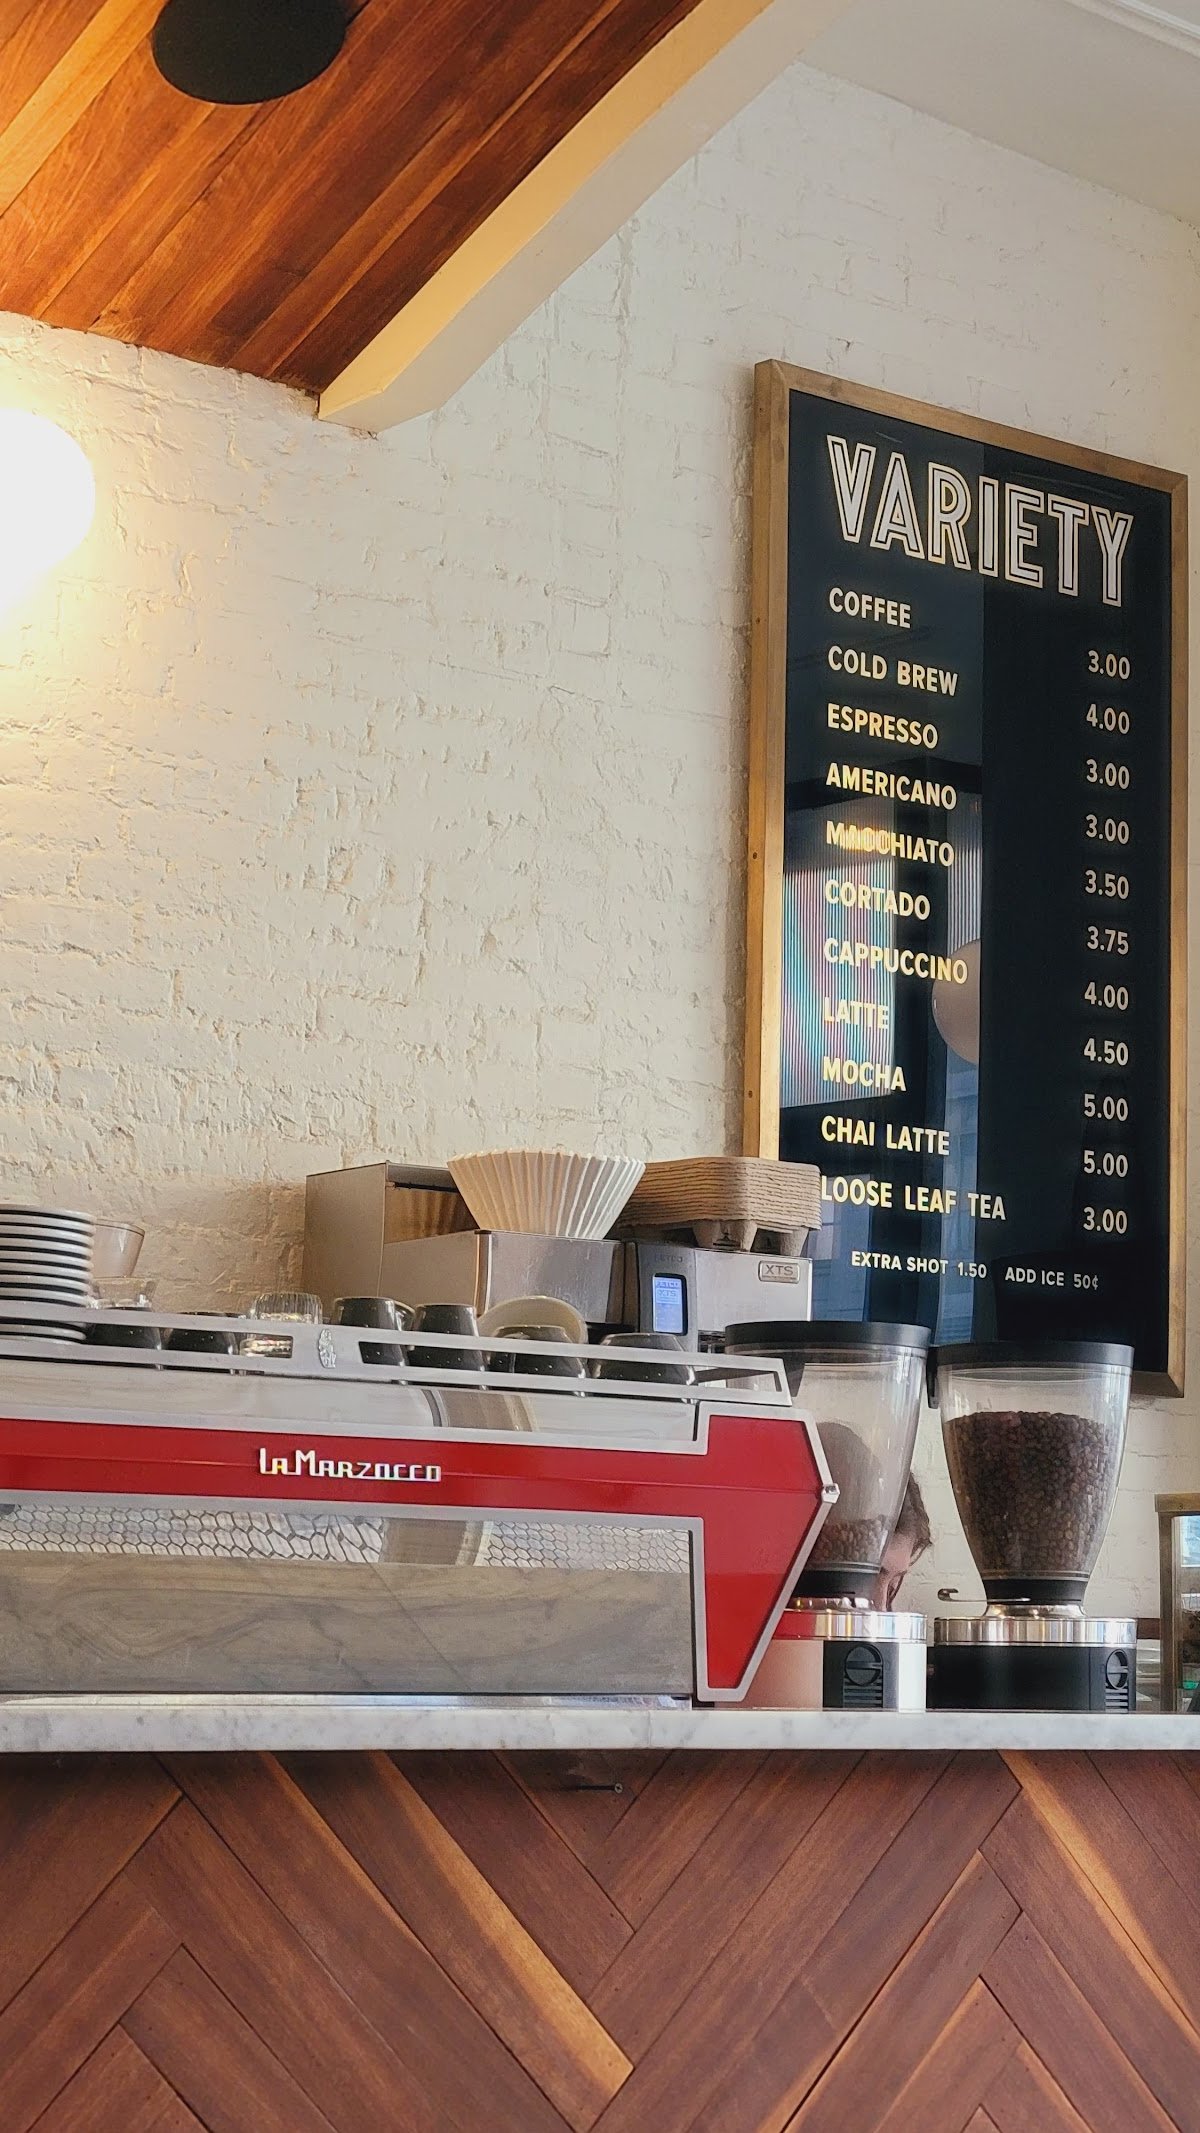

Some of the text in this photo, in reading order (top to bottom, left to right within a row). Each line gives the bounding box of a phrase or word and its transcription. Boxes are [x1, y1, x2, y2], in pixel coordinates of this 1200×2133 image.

[827, 434, 1134, 607] VARIETY
[829, 587, 1131, 680] COFFEE 3.00
[828, 645, 1130, 735] COLD BREW 4.00
[827, 703, 1130, 790] ESPRESSO 3.00
[825, 762, 1130, 845] AMERICANO 3.00
[826, 820, 1129, 900] MACCHIATO 3.50
[824, 879, 1129, 956] CORTADO 3.75
[824, 937, 1129, 1011] CAPPUCCINO 4.00
[823, 996, 1129, 1066] LATTE 4.50
[822, 1056, 1128, 1122] MOCHA 5.00
[821, 1115, 1128, 1178] CHAI LATTE 5.00
[821, 1175, 1127, 1235] LOOSE LEAF TEA 3.00
[765, 1264, 794, 1276] XTS
[851, 1250, 987, 1279] EXTRA SHOT 1.50
[1004, 1266, 1099, 1290] ADD ICE 50¢
